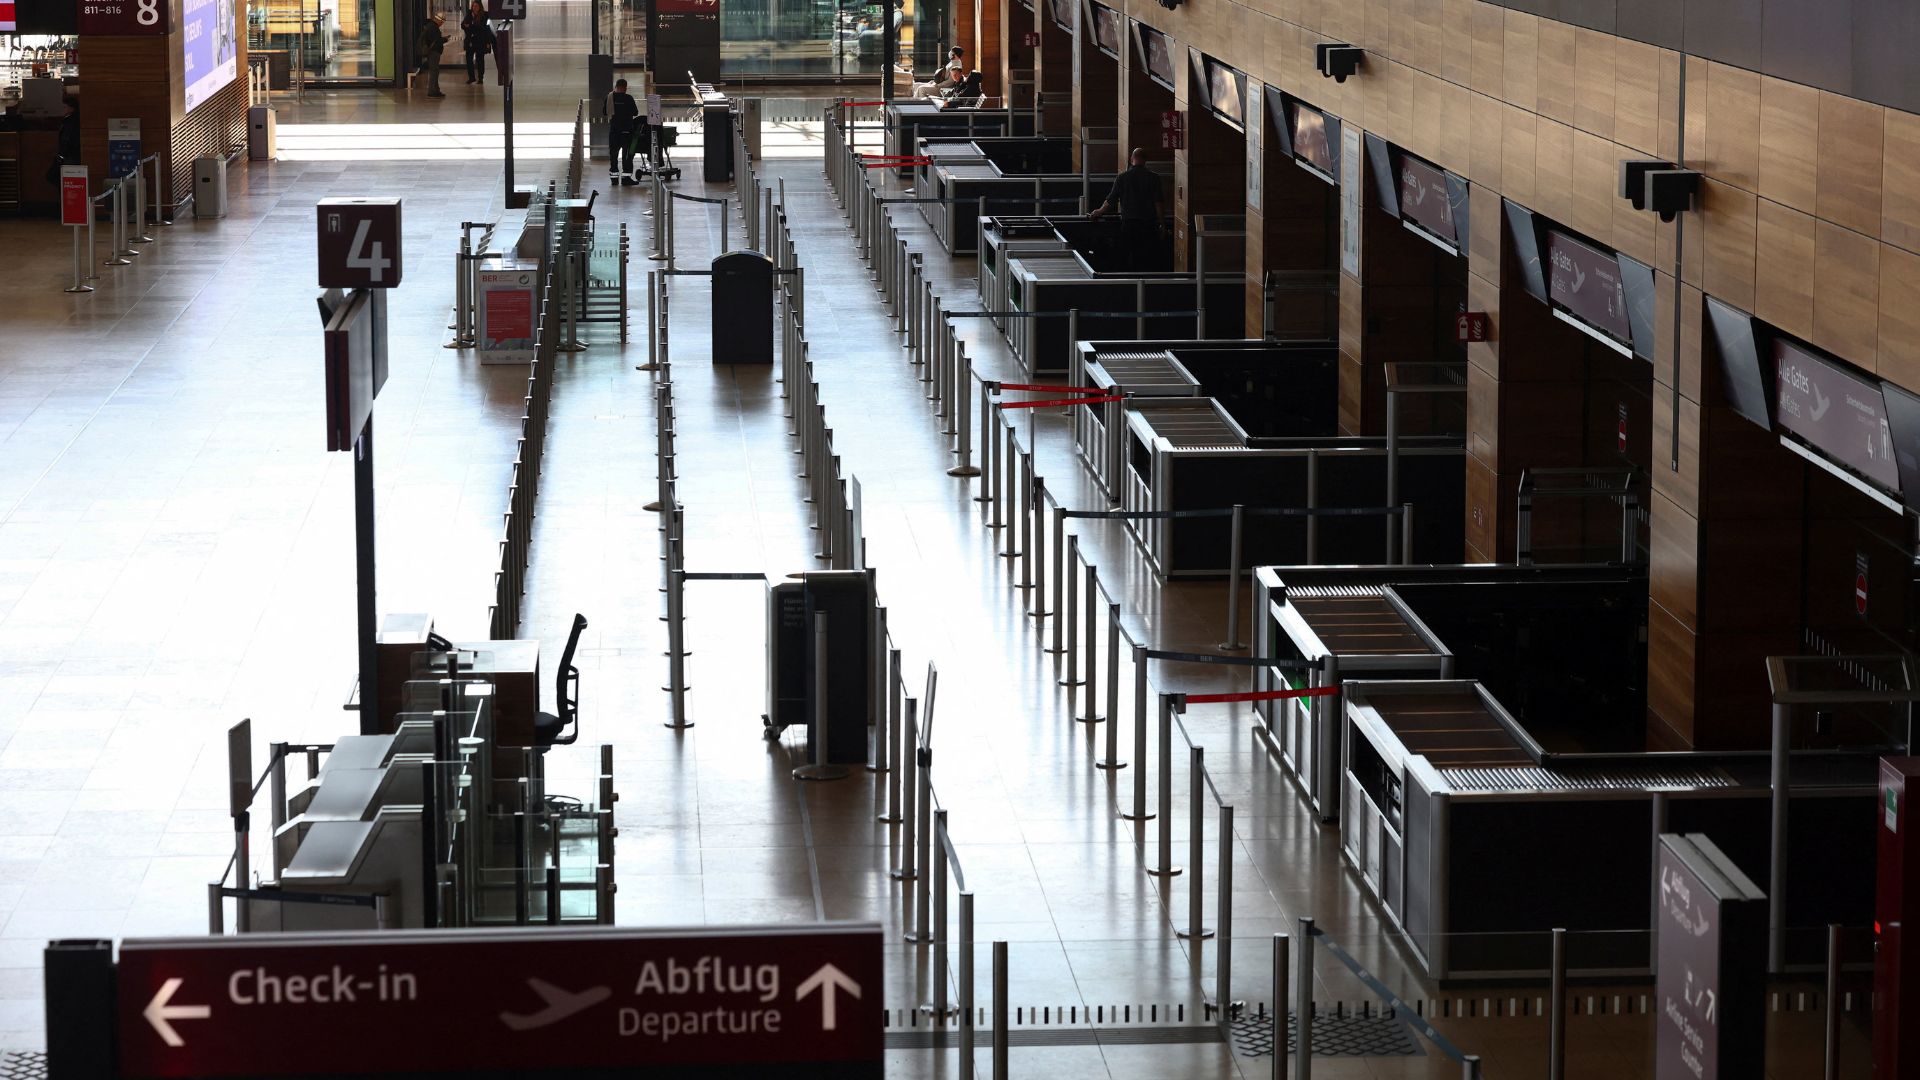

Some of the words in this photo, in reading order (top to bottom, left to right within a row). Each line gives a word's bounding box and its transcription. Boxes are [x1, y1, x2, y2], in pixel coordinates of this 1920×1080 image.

[136, 0, 159, 26] 8
[501, 0, 524, 16] 4
[346, 219, 392, 282] 4
[482, 274, 498, 282] BER
[1778, 358, 1790, 384] Alle
[1791, 365, 1809, 394] Gates
[228, 964, 417, 1004] Check-in
[635, 956, 780, 1002] Abflug
[618, 1006, 782, 1042] Departure
